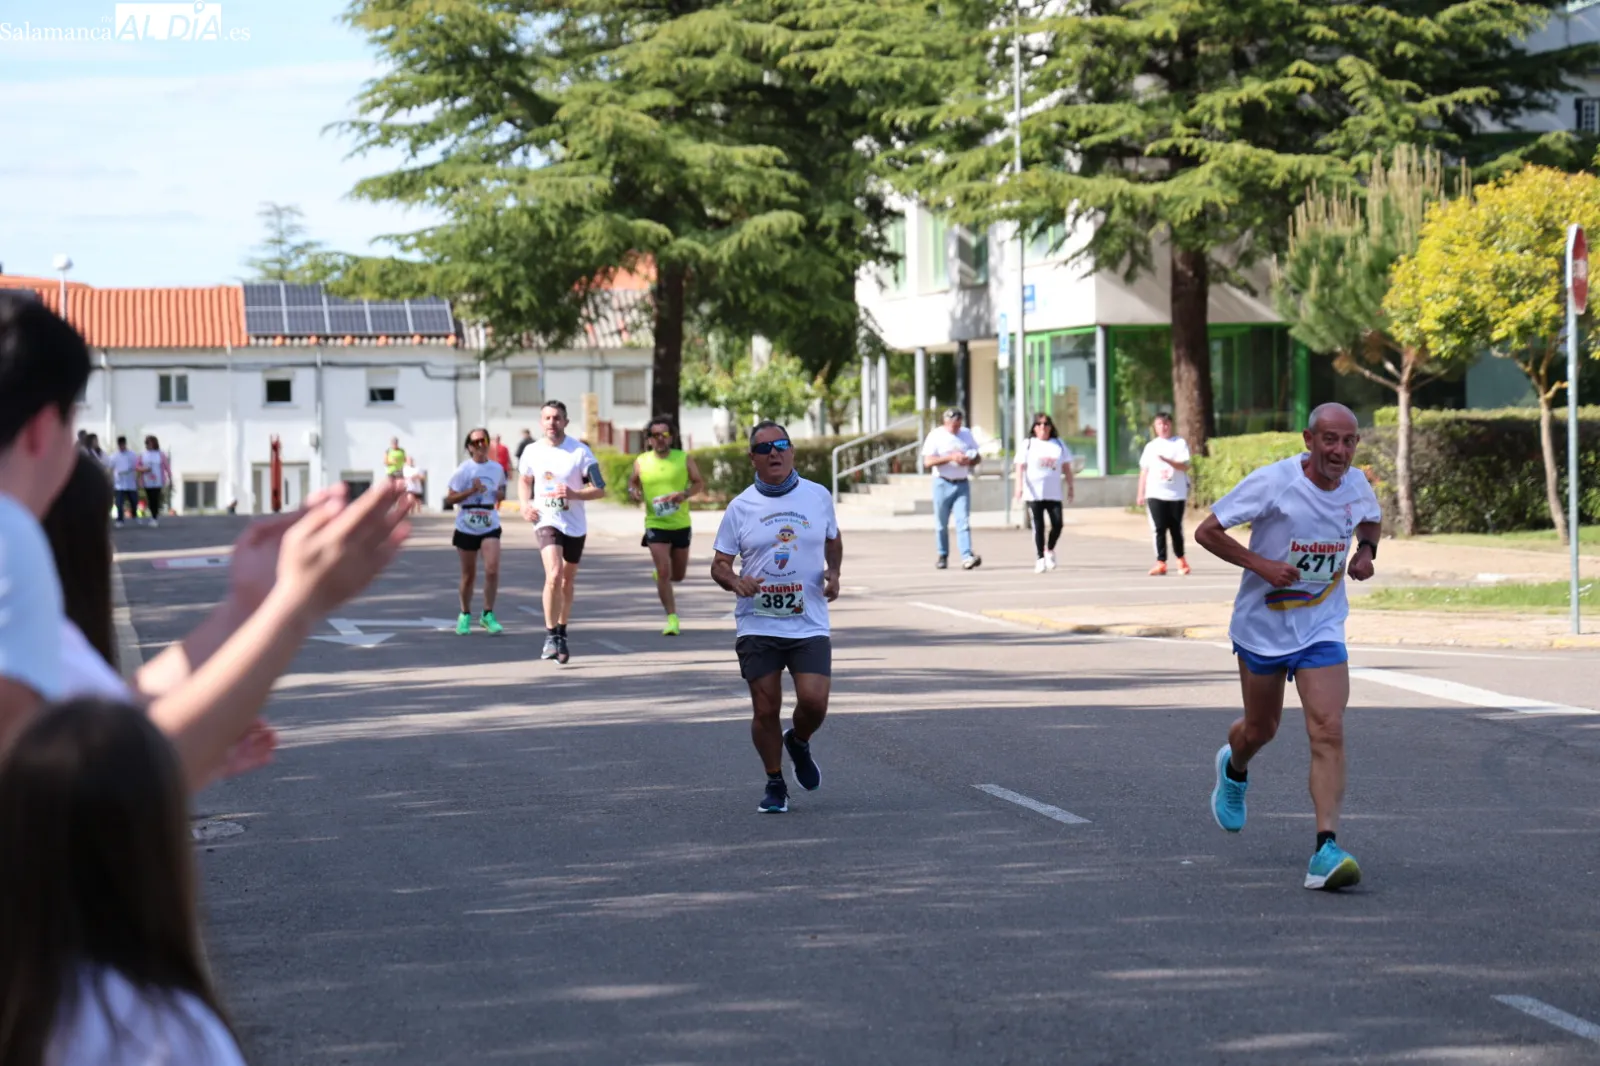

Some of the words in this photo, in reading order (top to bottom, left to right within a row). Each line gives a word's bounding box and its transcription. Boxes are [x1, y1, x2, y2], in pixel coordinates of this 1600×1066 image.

[1290, 541, 1346, 553] bedunia
[1296, 554, 1337, 573] 471
[759, 582, 803, 593] edunia
[761, 593, 796, 609] 382
